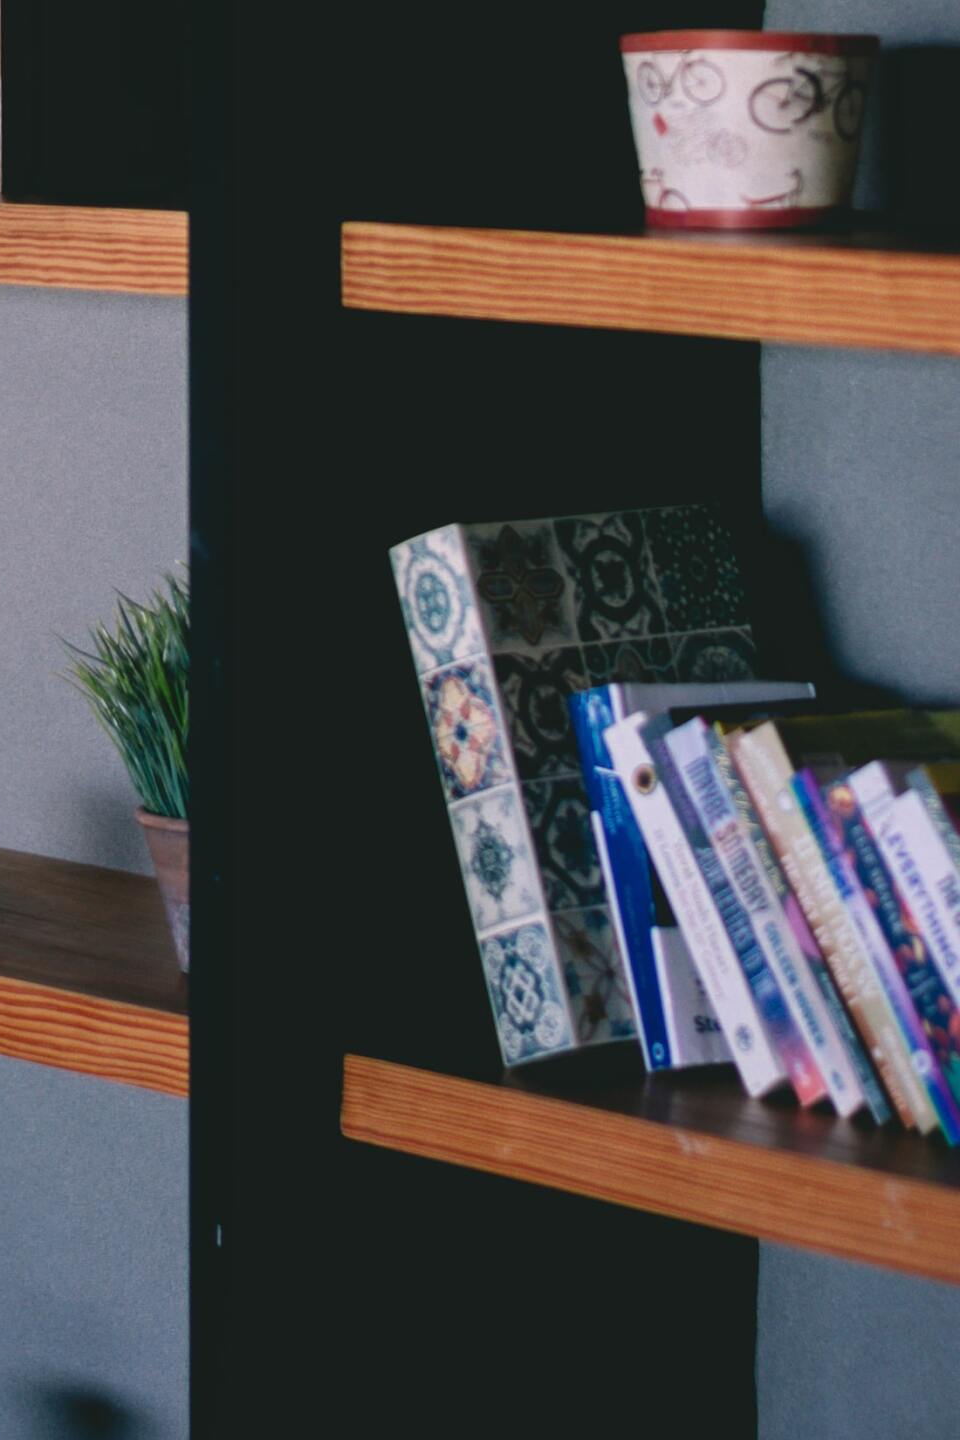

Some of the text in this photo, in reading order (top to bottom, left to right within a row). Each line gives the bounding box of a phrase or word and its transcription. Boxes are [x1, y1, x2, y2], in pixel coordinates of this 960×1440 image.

[682, 754, 733, 827] MAYBE
[711, 821, 770, 917] SOMEDAY
[884, 831, 960, 969] EVERYTHING
